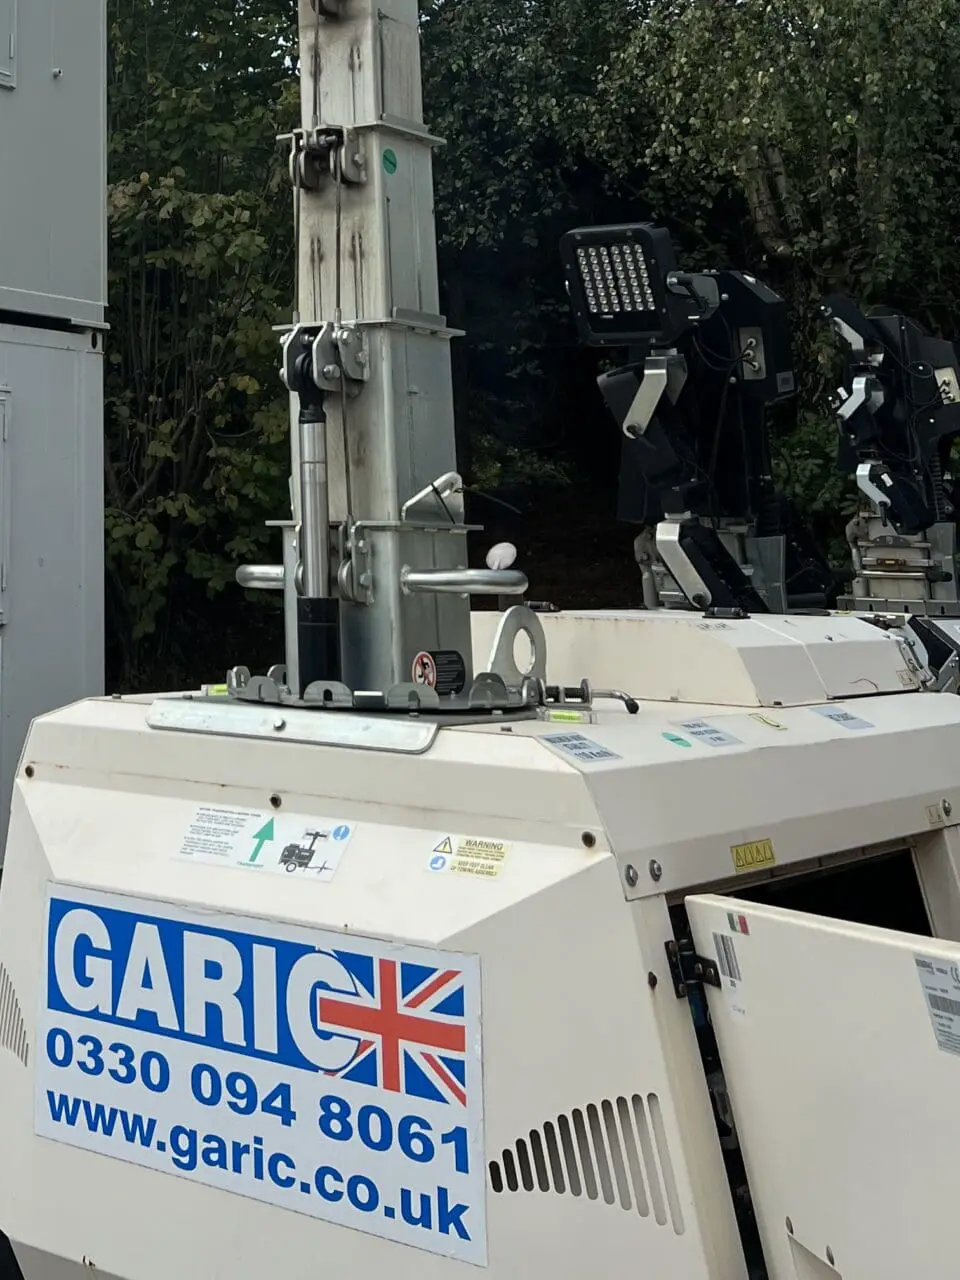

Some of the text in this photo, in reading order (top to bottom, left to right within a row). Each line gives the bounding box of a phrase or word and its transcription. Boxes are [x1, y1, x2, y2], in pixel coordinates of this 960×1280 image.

[465, 840, 504, 850] WARNING
[54, 907, 361, 1071] GARIC
[46, 1027, 470, 1175] 0330 094 8061
[46, 1089, 472, 1241] www.garic.co.uk
